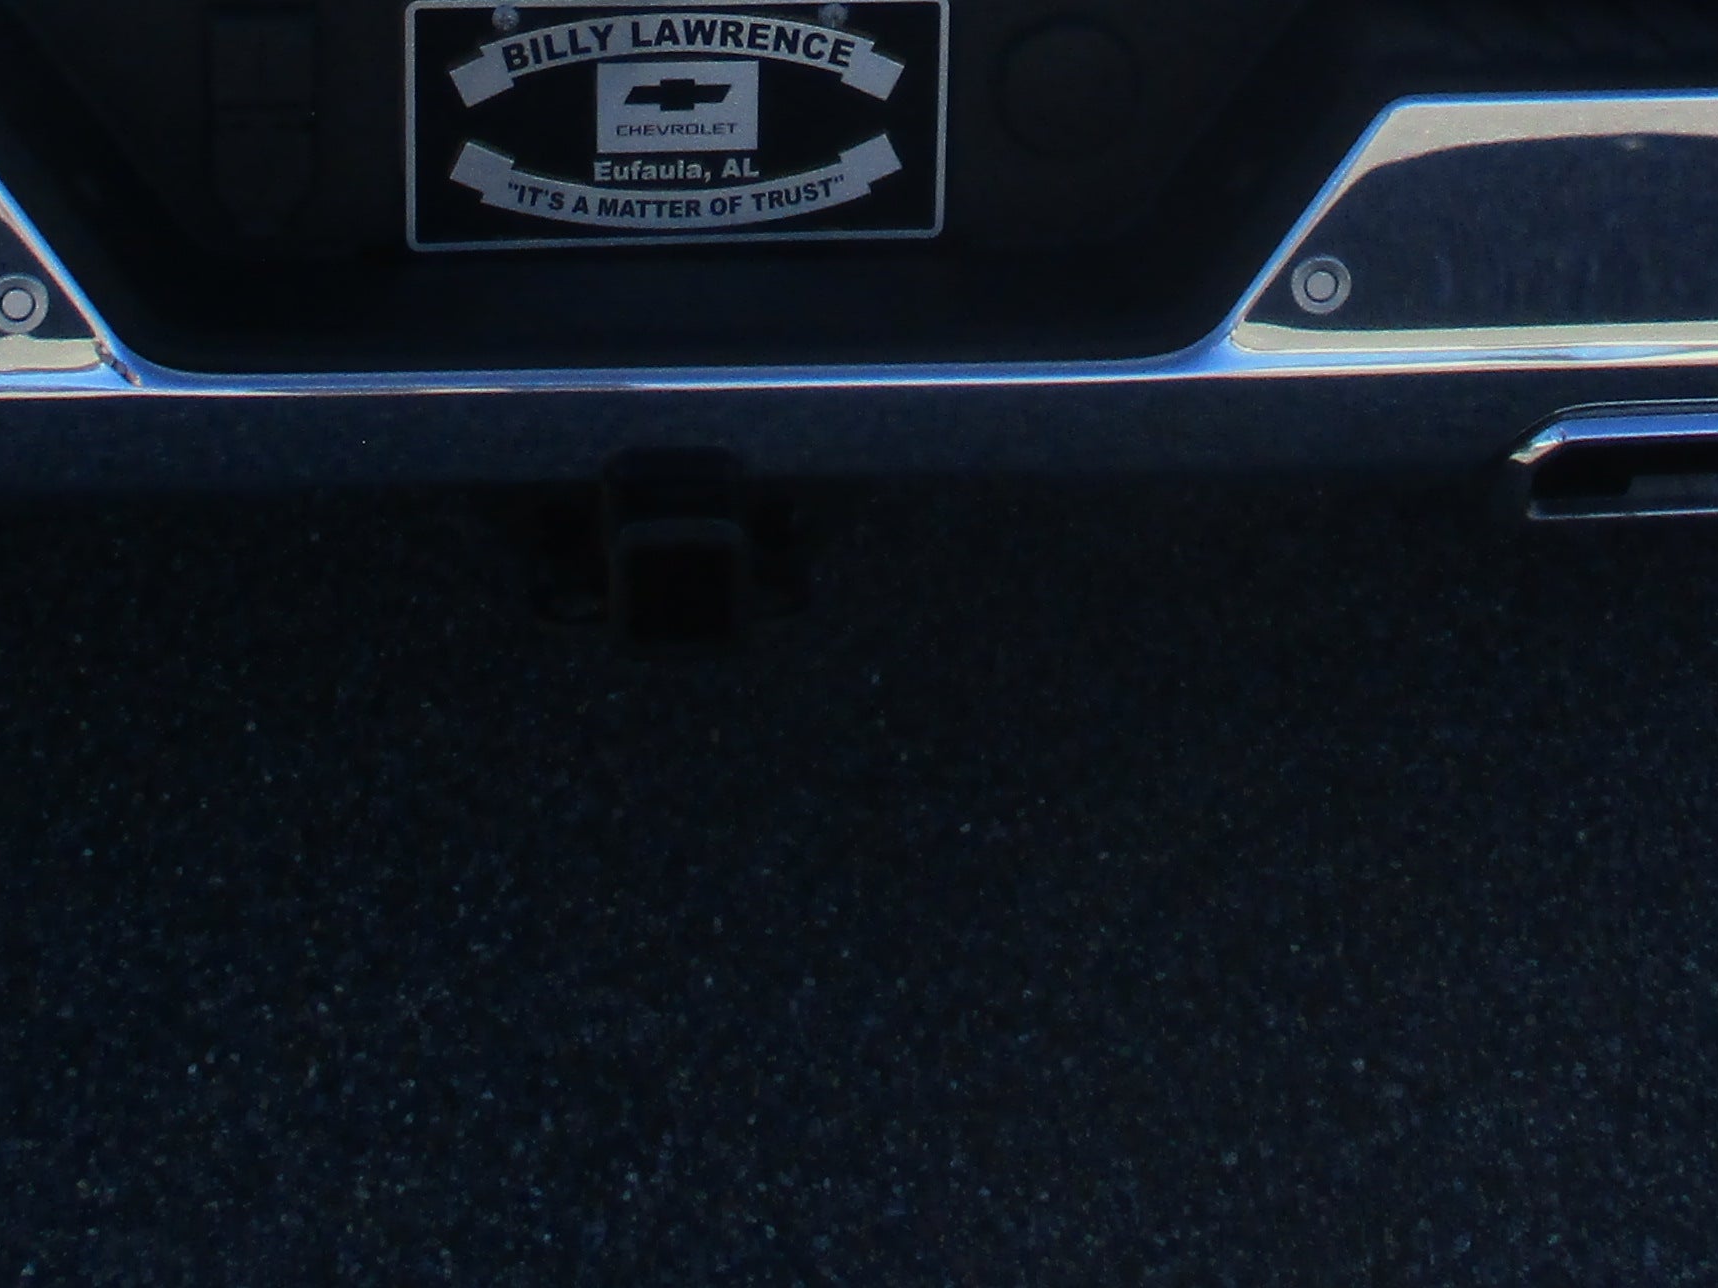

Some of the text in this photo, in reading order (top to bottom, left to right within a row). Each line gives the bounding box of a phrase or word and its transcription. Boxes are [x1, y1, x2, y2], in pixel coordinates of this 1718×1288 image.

[501, 19, 856, 72] BILLY LAWRENCE
[616, 122, 738, 137] CHEVROLET
[720, 157, 760, 179] AL
[507, 174, 846, 219] "IT'S A MATTER OF TRUST"
